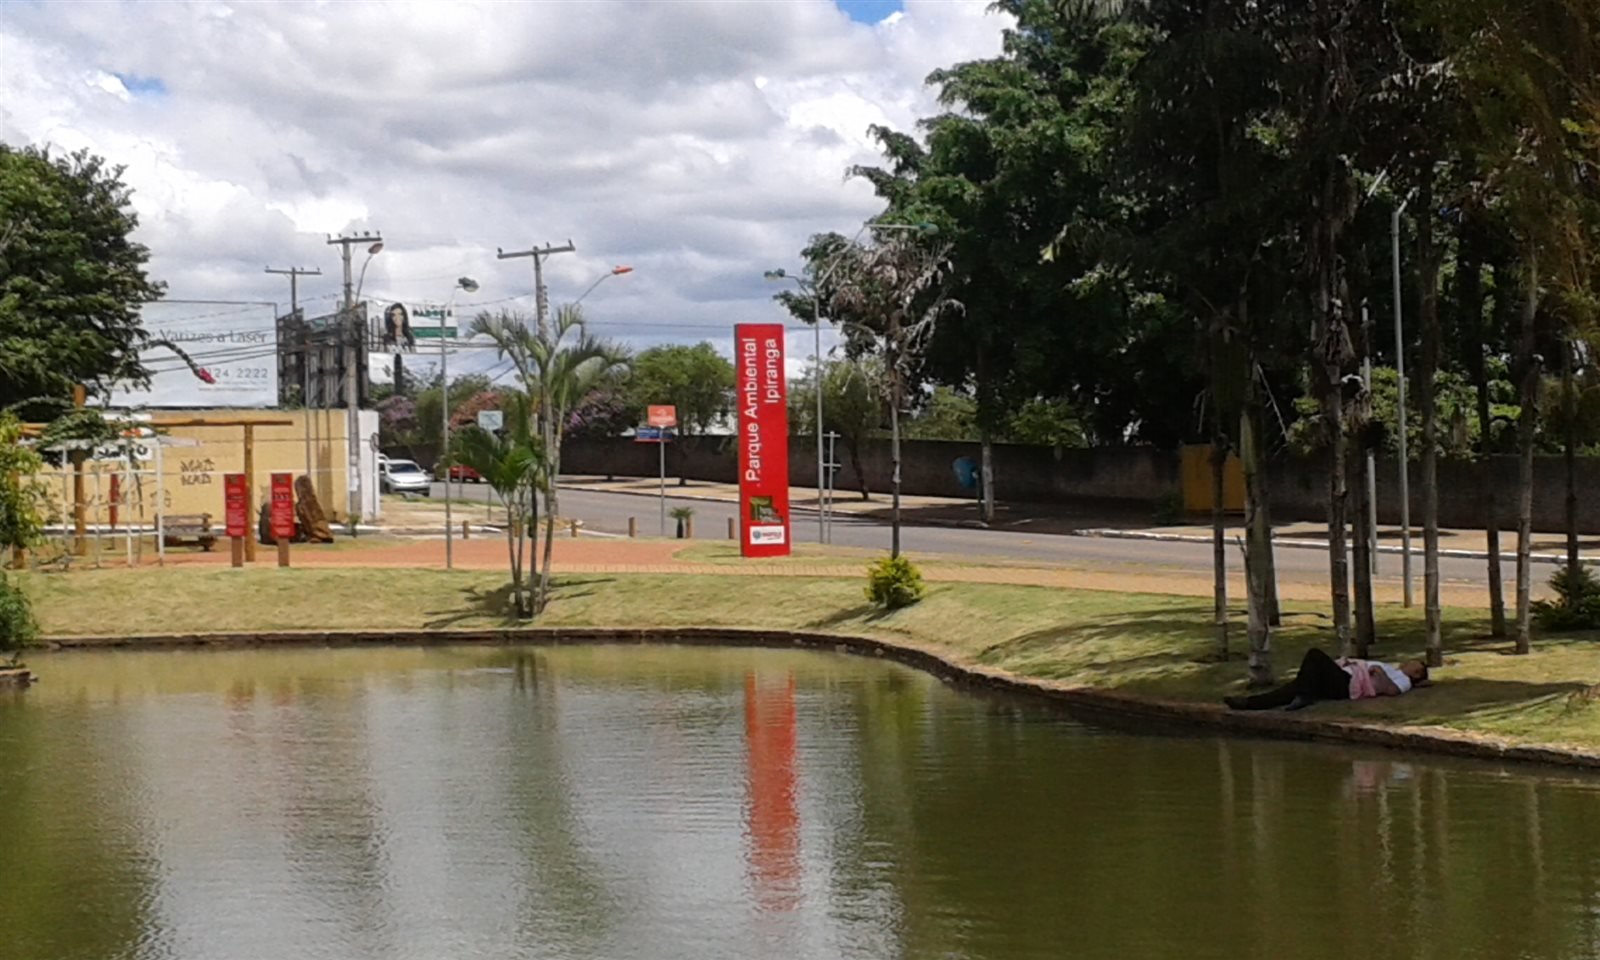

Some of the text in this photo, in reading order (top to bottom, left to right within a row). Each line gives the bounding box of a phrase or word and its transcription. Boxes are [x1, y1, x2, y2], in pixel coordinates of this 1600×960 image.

[237, 368, 268, 378] 2222
[764, 338, 781, 404] Ipiranga
[742, 338, 762, 482] Parque Ambiental
